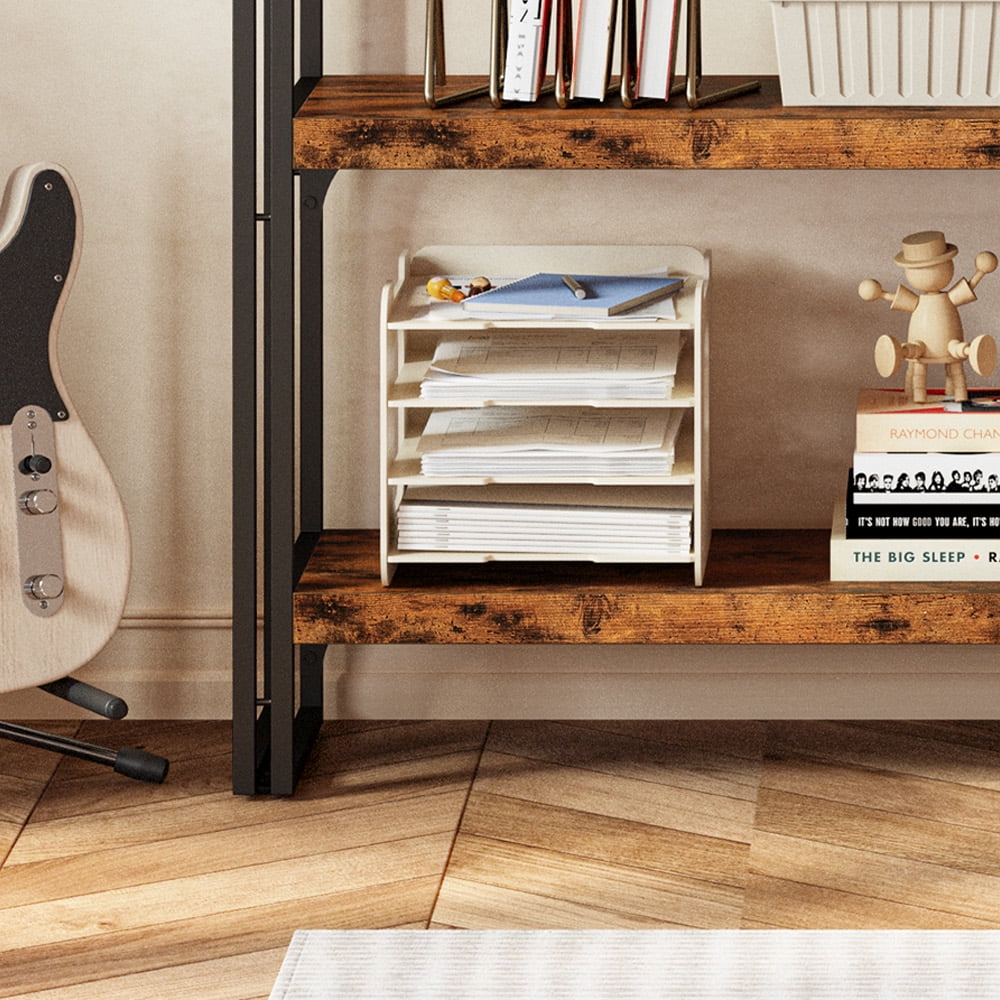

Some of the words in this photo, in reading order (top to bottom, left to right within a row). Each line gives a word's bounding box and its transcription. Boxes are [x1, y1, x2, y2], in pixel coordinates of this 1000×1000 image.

[889, 428, 960, 440] RAYMOND
[858, 516, 873, 527] IT'S
[875, 516, 890, 527] NOT
[892, 516, 909, 527] HOW
[912, 516, 933, 527] GOOD
[934, 516, 950, 527] YOU
[952, 516, 970, 529] ARE,
[972, 516, 987, 527] IT'S
[853, 551, 881, 563] THE
[888, 551, 916, 563] BIG
[922, 551, 966, 563] SLEEP
